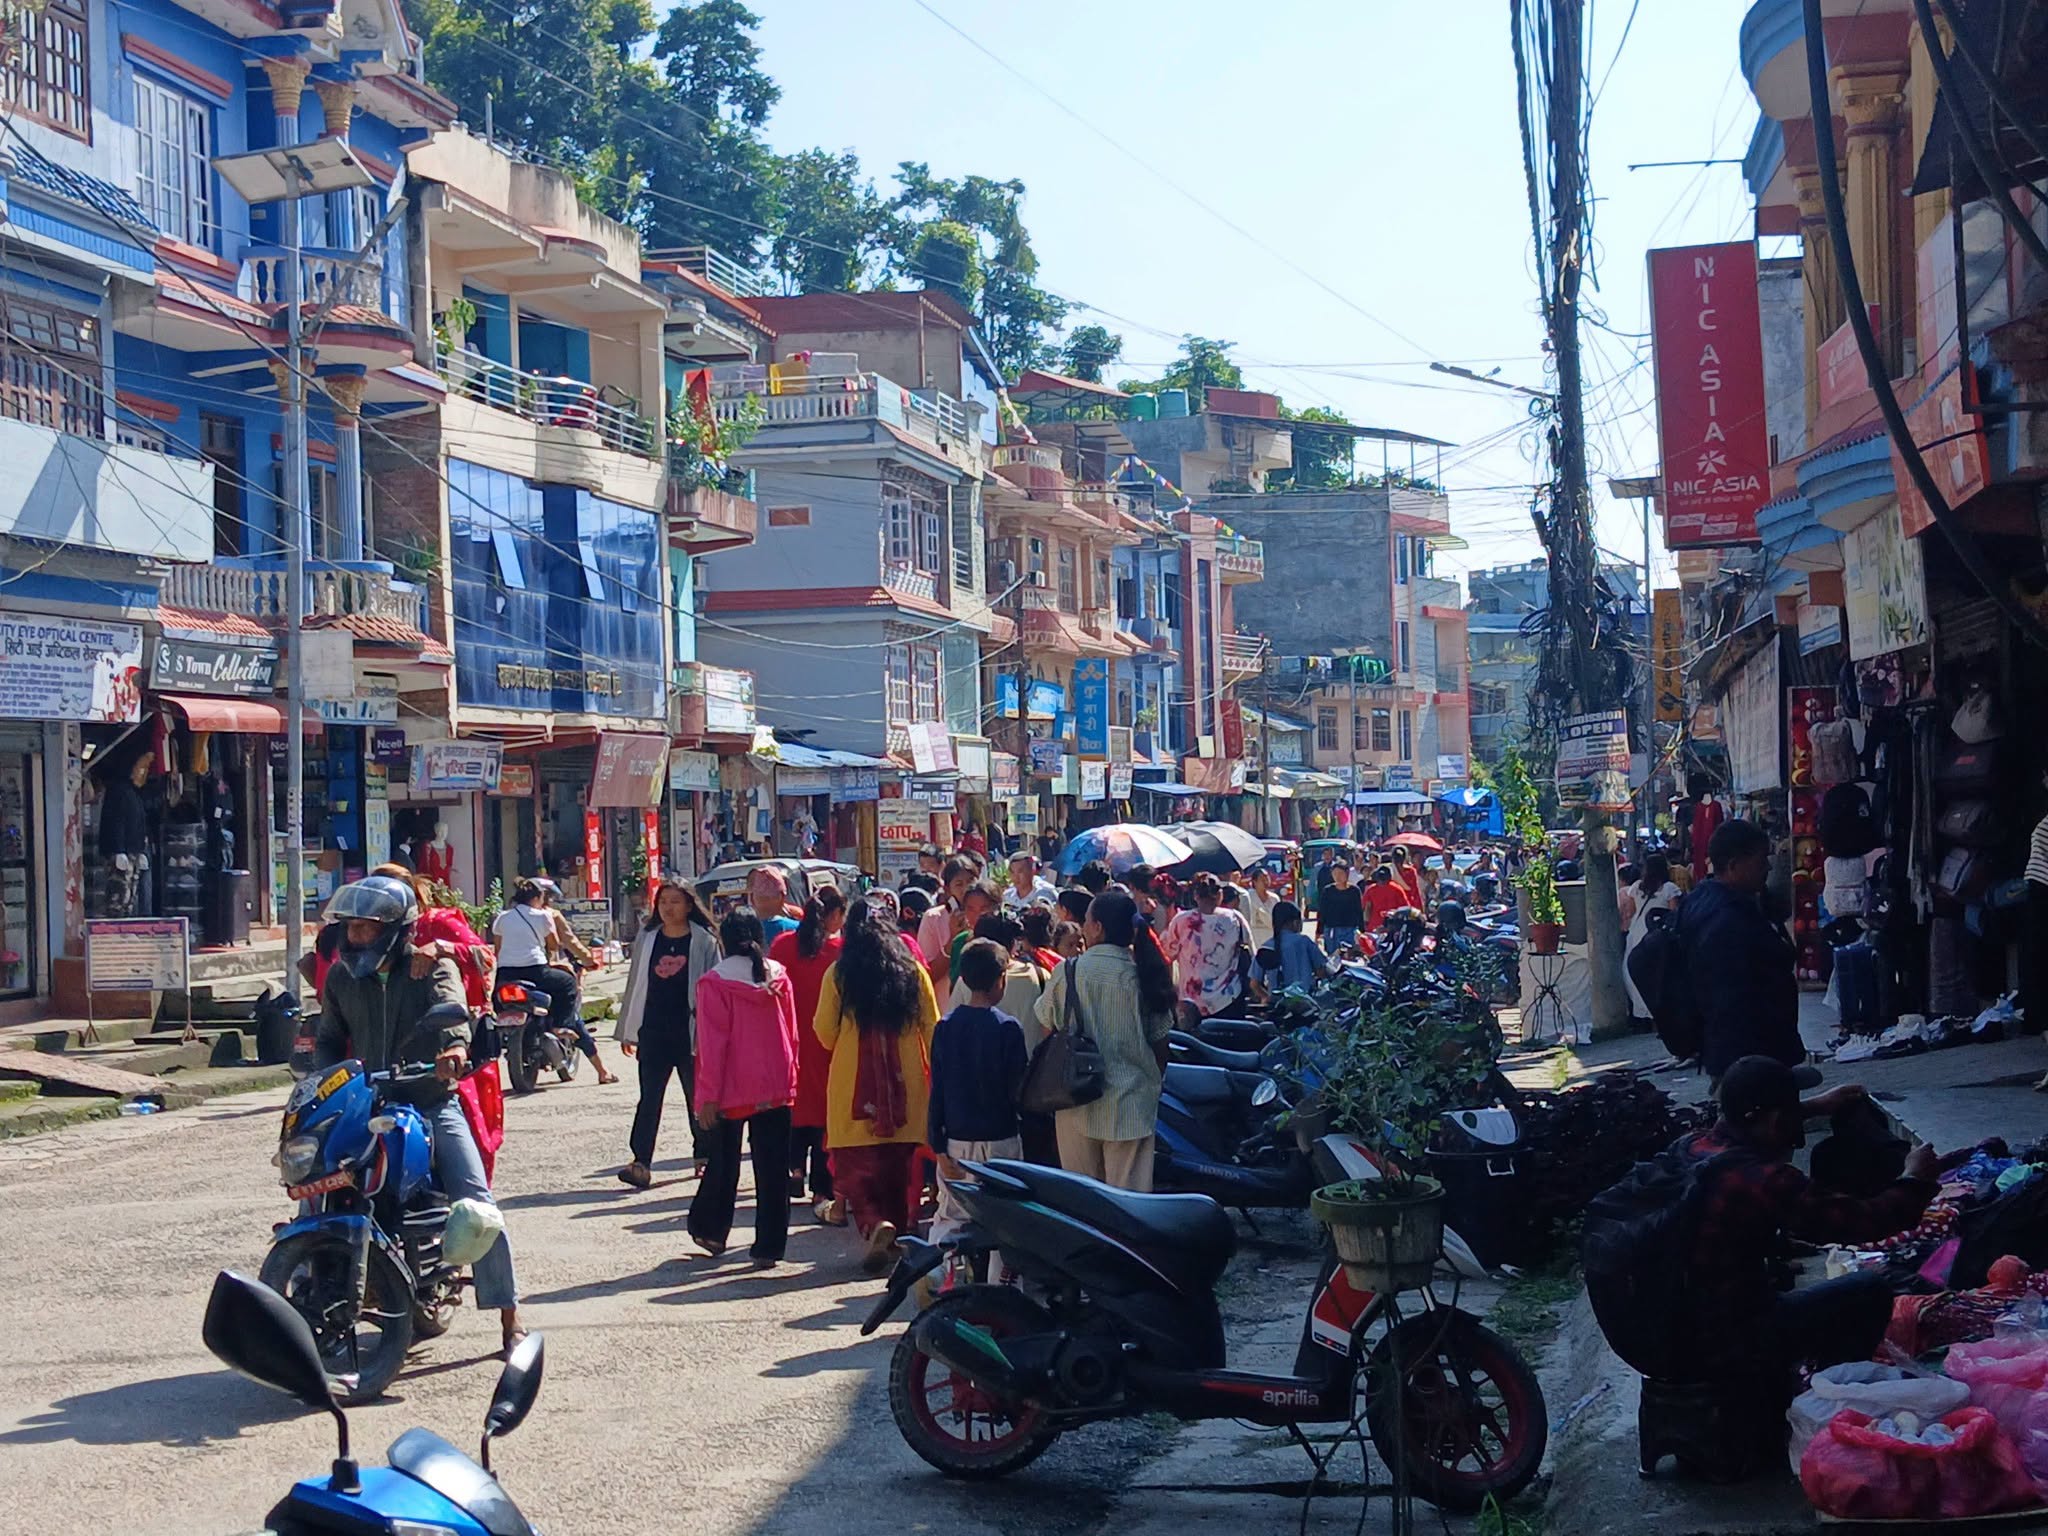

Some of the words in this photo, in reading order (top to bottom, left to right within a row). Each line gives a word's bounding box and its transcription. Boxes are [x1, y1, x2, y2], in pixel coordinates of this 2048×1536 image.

[1694, 256, 1717, 331] NIC
[1699, 343, 1726, 443] ASIA
[1673, 479, 1707, 496] NIC
[1712, 475, 1761, 494] ASIA
[0, 623, 16, 638] ITY
[17, 625, 36, 639] EYE
[37, 627, 77, 643] OPTICAL
[79, 631, 114, 646] CENTRE
[5, 637, 24, 656] सिटी
[175, 655, 184, 673] S
[212, 653, 272, 685] Collection
[1559, 710, 1622, 728] Admission
[1570, 722, 1613, 737] OPEN
[377, 739, 403, 750] Ncell
[1199, 1164, 1241, 1180] HONDA
[1262, 1389, 1320, 1407] aprilia
